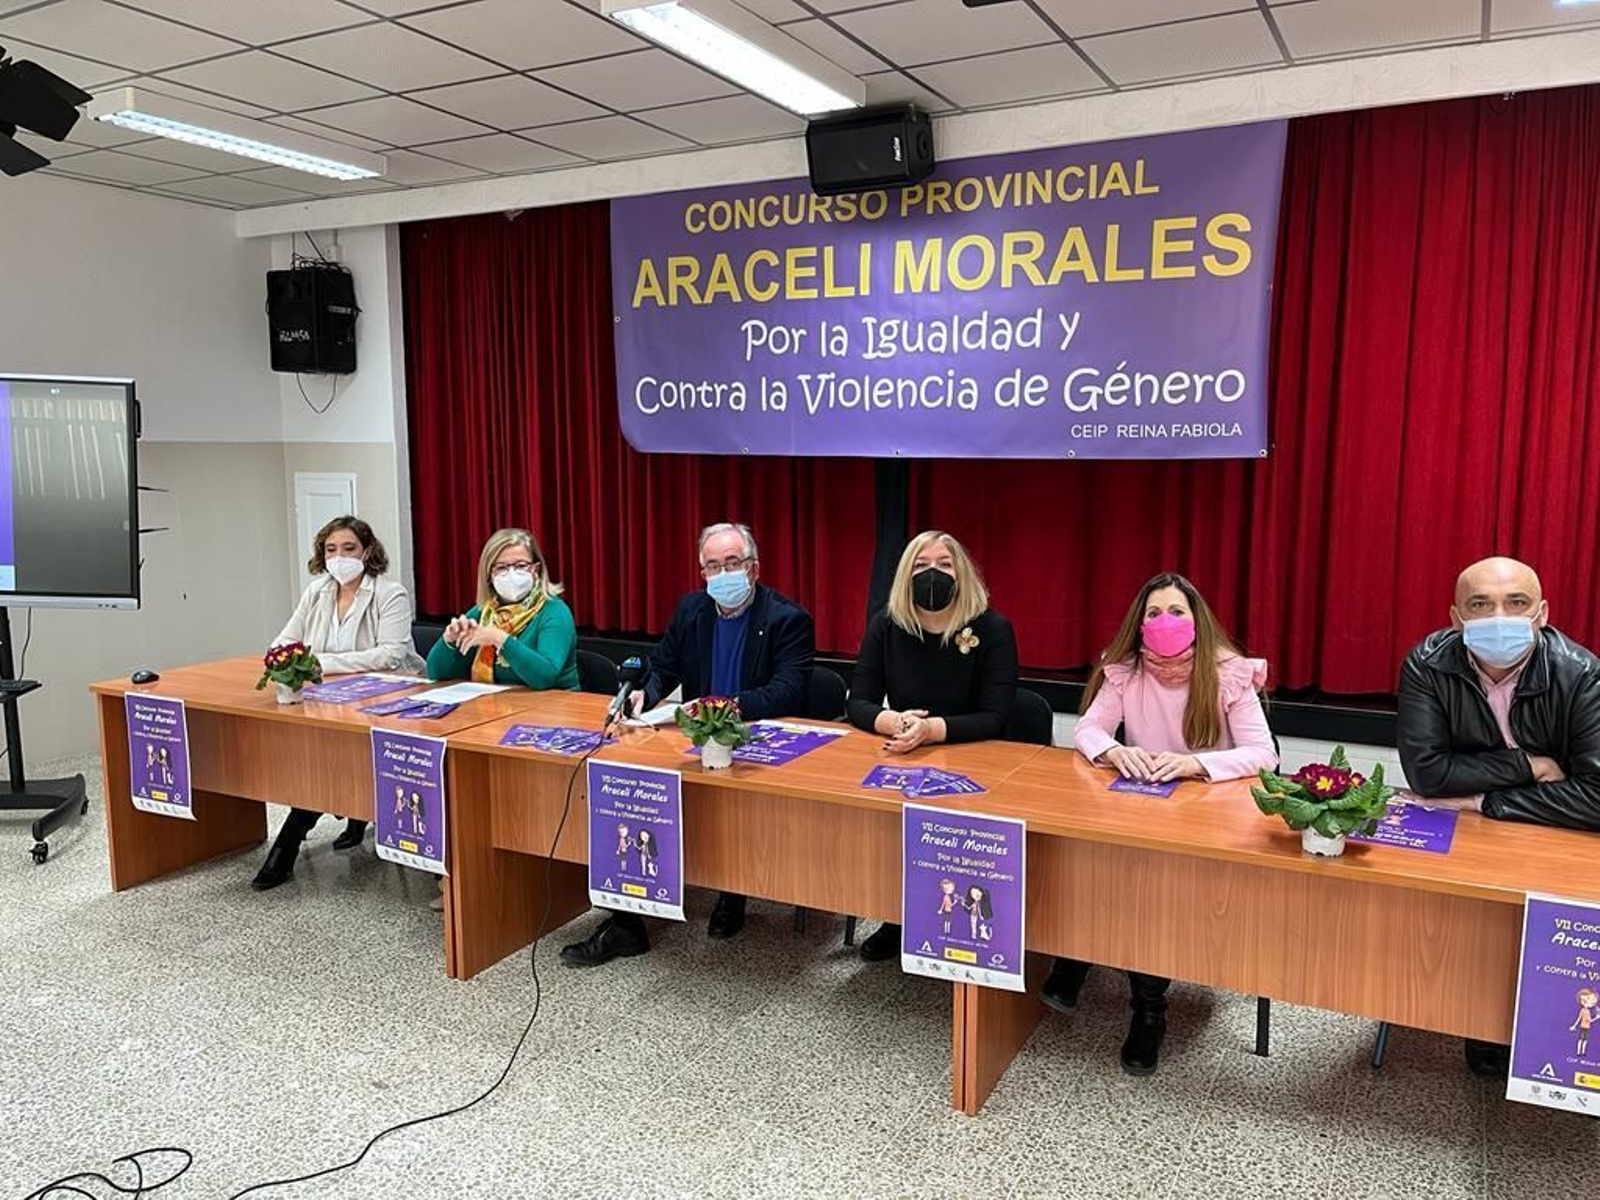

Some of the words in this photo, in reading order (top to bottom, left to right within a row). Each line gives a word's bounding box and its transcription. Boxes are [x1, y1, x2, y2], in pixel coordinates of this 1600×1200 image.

[684, 190, 888, 234] CONCURSO
[900, 158, 1160, 217] PROVINCIAL
[632, 242, 871, 308] ARACELI
[893, 211, 1253, 294] MORALES
[741, 319, 807, 361] Por
[821, 321, 849, 357] la
[861, 307, 1043, 360] Igualdad
[1058, 311, 1080, 351] y
[635, 376, 746, 414] Contra
[761, 376, 787, 412] la
[797, 369, 979, 415] Violencia
[994, 368, 1049, 408] de
[1063, 361, 1246, 412] Género
[1071, 424, 1108, 438] CEIP
[1116, 424, 1168, 438] REINA
[1171, 422, 1243, 437] FABIOLA
[601, 784, 631, 797] Araceli
[634, 789, 668, 802] Morales
[921, 833, 959, 848] Araceli
[963, 839, 1008, 855] Morales
[1554, 918, 1571, 930] VII
[1575, 956, 1597, 968] Por
